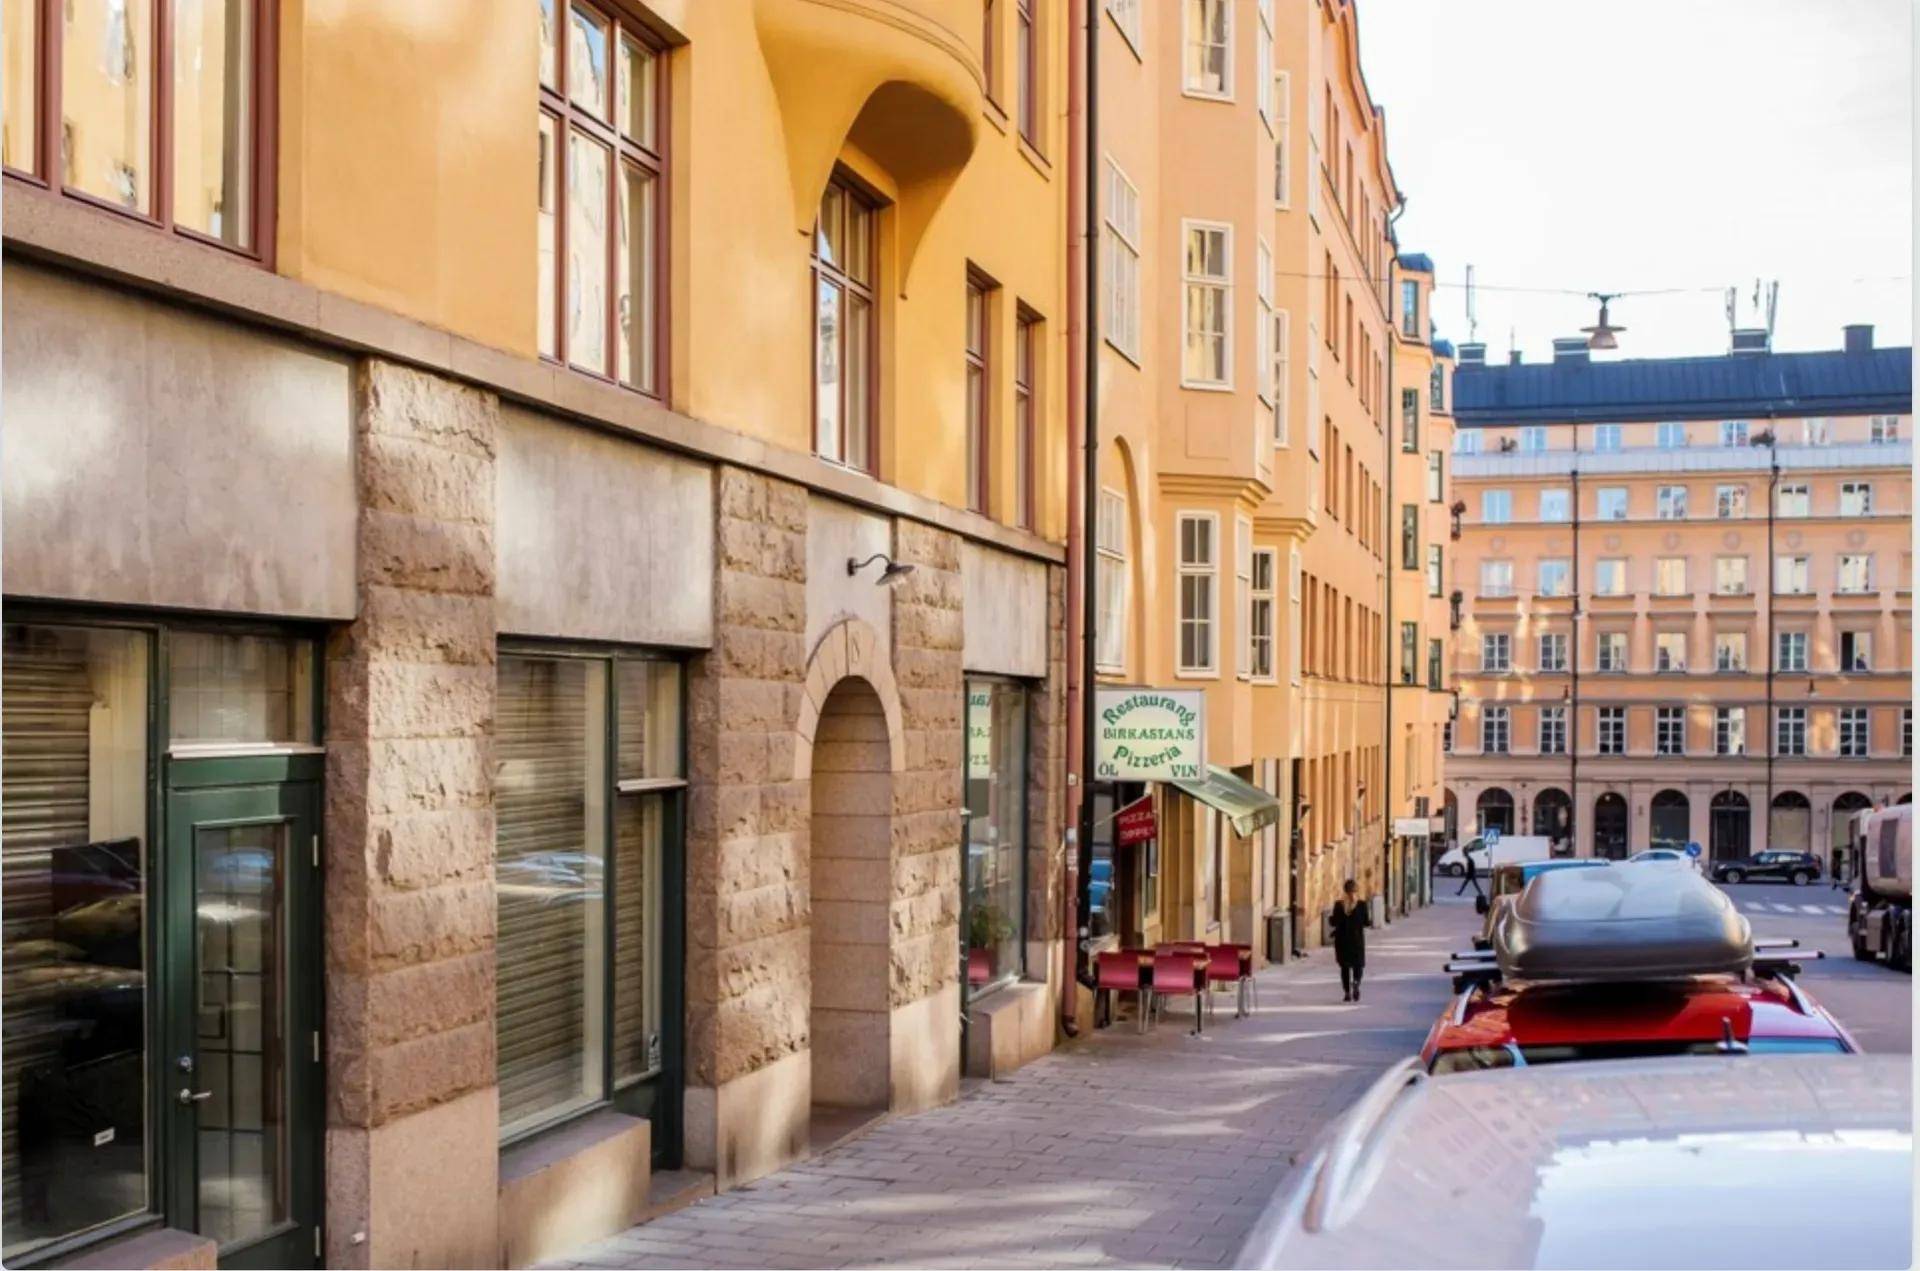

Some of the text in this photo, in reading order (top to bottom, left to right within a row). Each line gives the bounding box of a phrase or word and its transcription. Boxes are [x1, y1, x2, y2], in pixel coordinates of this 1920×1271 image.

[1102, 694, 1196, 727] Restaurang
[1103, 728, 1195, 740] BIRKASTANS
[1112, 745, 1182, 768] Pizzeria
[1098, 761, 1199, 777] ÖL VIN
